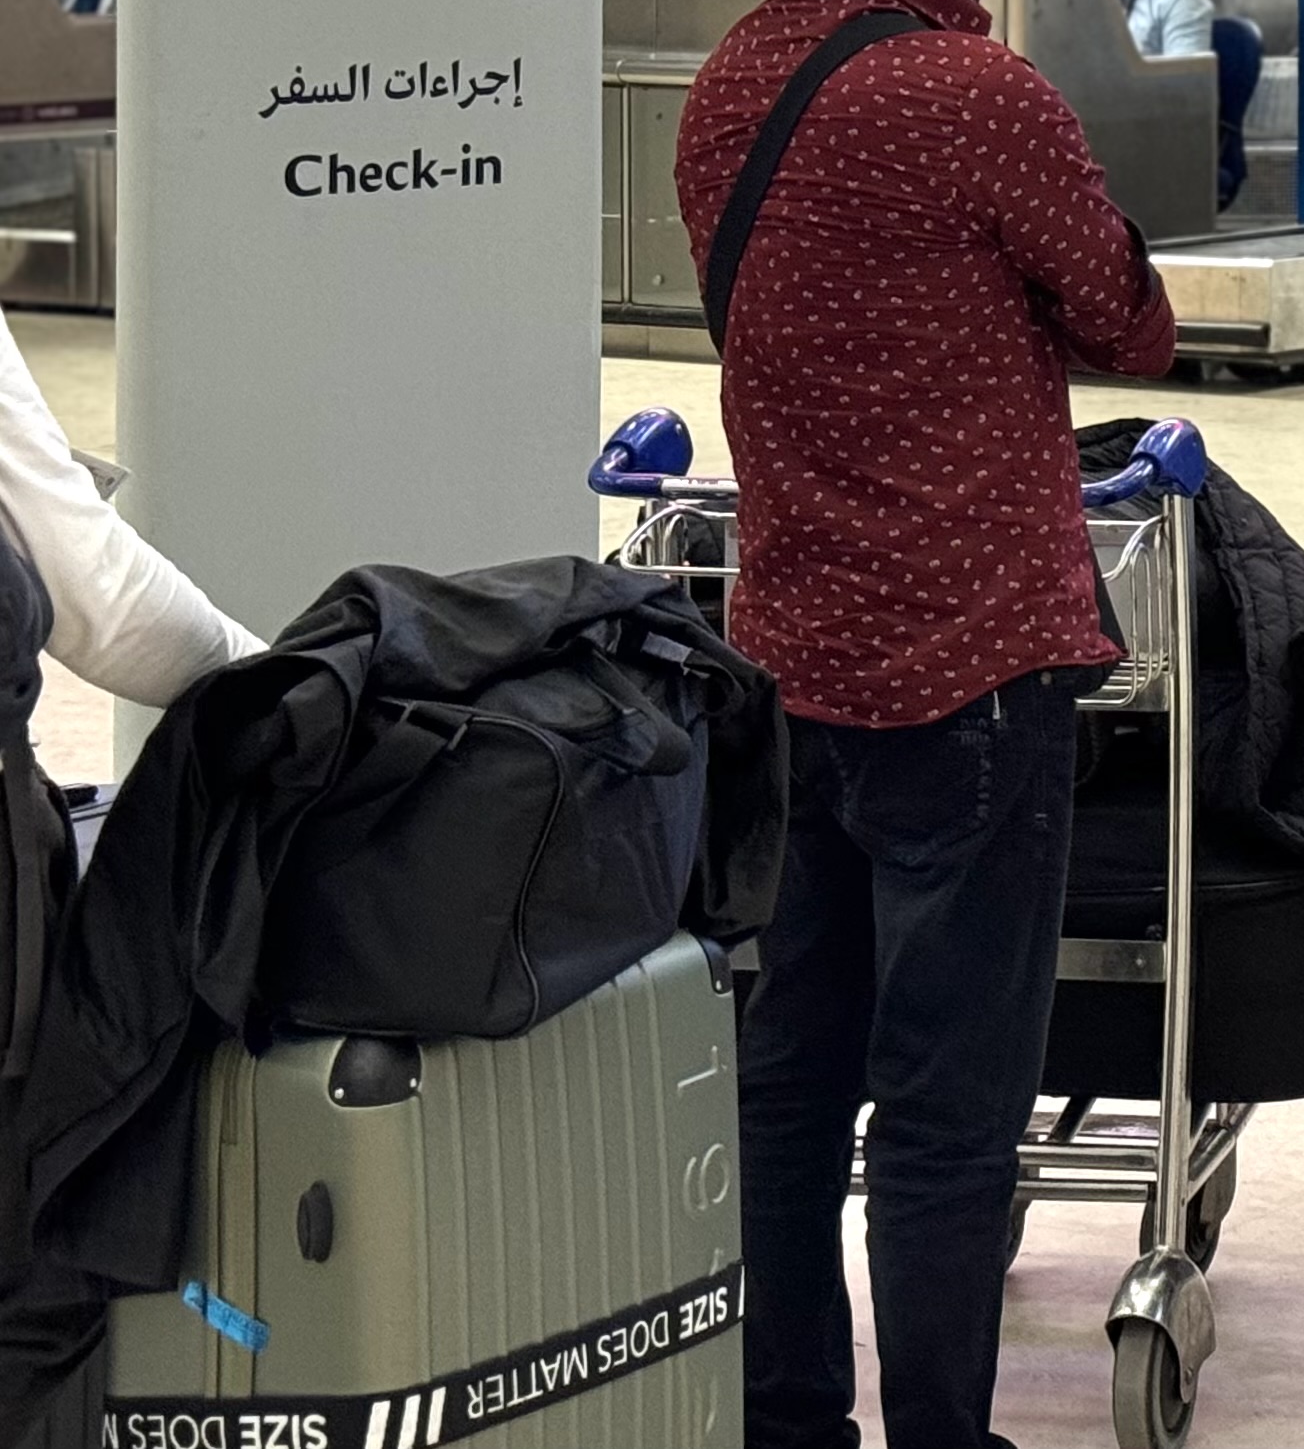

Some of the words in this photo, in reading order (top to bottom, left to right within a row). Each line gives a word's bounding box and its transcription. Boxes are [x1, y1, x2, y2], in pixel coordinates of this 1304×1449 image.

[257, 62, 371, 119] السفر
[384, 56, 523, 109] إجراءات
[284, 143, 502, 197] Check-in
[679, 1286, 729, 1341] SIZE
[597, 1310, 671, 1374] DOES
[466, 1342, 589, 1420] MATTER
[127, 1413, 227, 1449] DOES
[238, 1413, 329, 1449] SIZE
